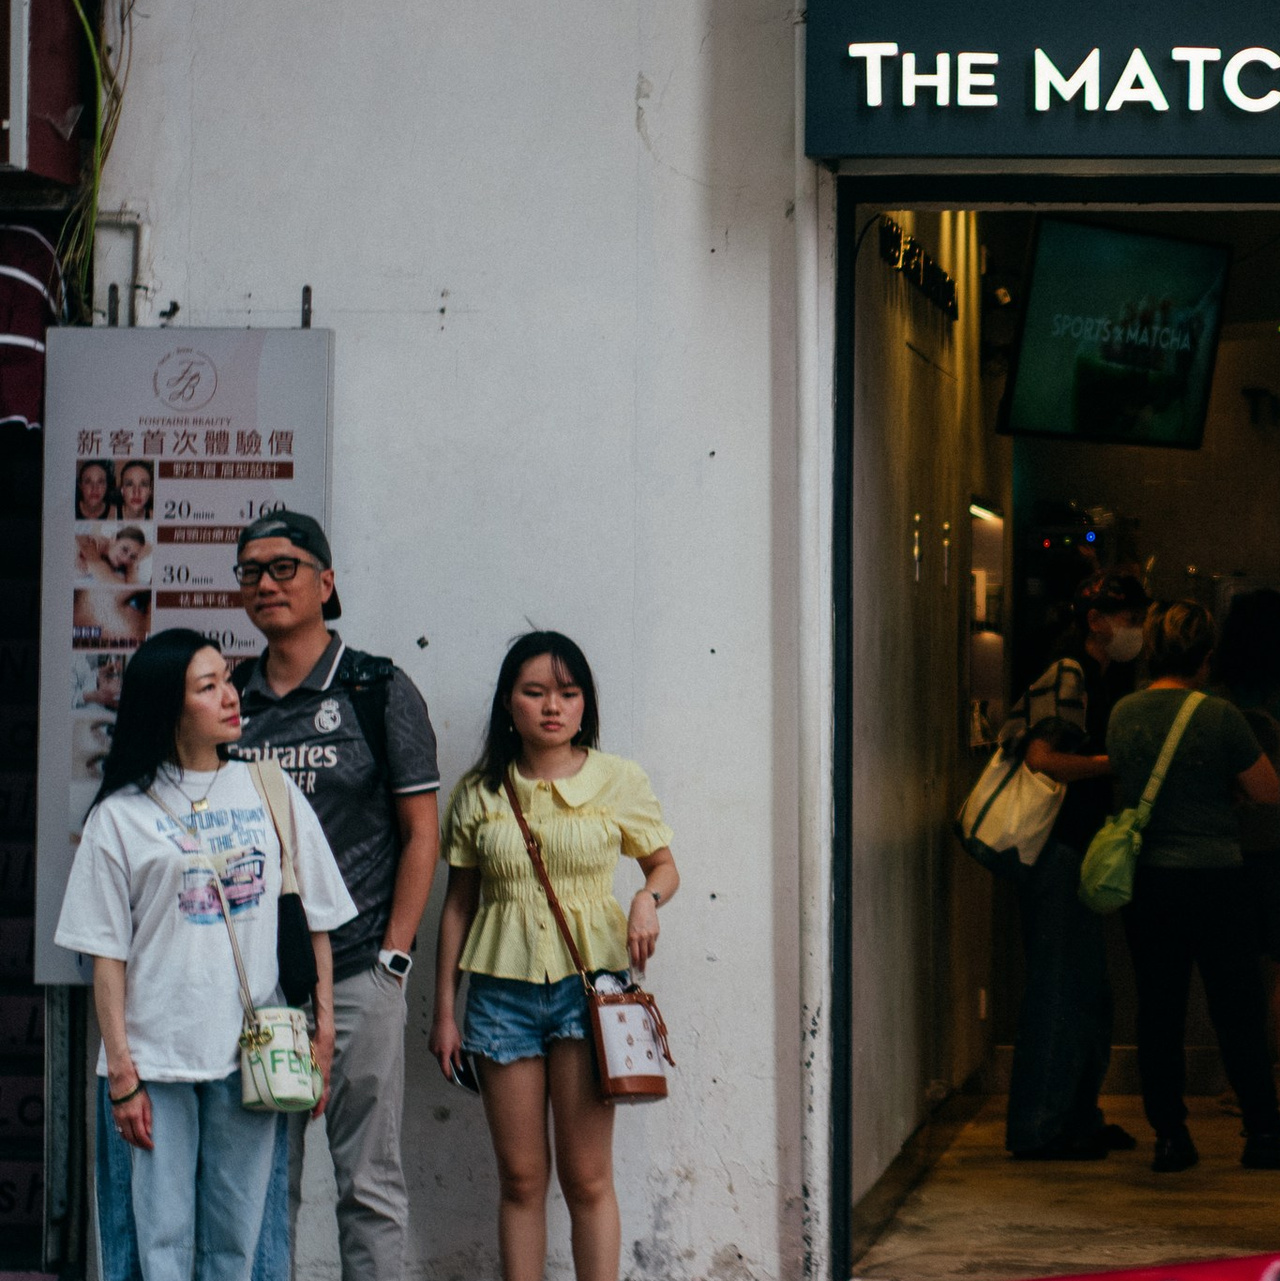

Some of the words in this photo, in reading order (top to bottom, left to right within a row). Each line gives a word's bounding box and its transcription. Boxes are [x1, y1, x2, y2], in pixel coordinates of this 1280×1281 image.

[847, 41, 999, 108] THE
[1051, 314, 1113, 343] SPORTS
[1126, 325, 1192, 351] MATCHA
[192, 416, 232, 426] BEAUTY
[77, 429, 295, 456] 新客首次體驗價
[164, 500, 191, 520] 20
[163, 565, 190, 584] 30
[209, 833, 234, 854] THE
